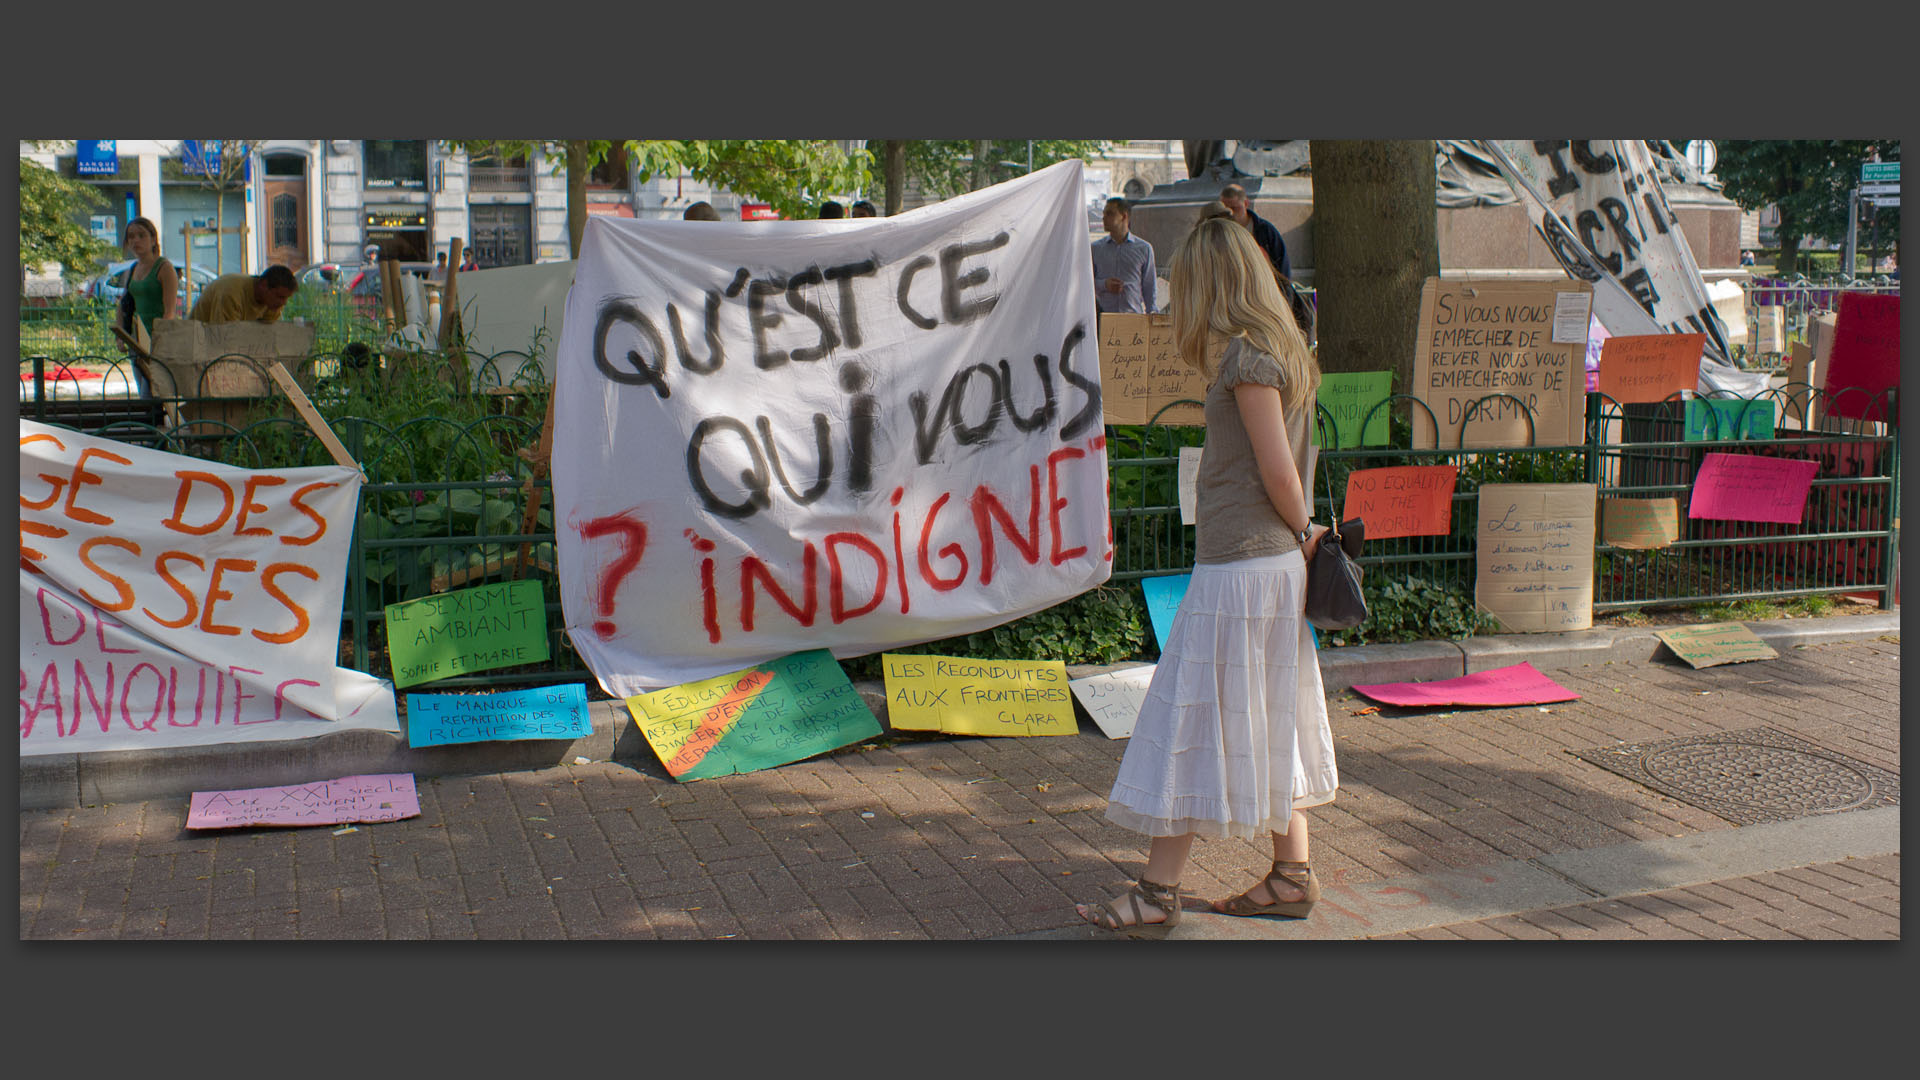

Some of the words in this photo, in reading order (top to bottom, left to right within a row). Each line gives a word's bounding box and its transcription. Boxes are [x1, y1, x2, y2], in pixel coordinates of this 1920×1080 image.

[594, 259, 878, 398] QU'EST
[897, 232, 1010, 331] CE
[1464, 305, 1500, 324] VOUS
[1505, 305, 1551, 323] NOUS
[1518, 331, 1543, 349] DE
[1432, 351, 1480, 367] REVER
[1490, 352, 1530, 370] NOUS
[1536, 352, 1567, 367] VOUS
[1432, 371, 1534, 389] EMPECHERONS
[1544, 370, 1563, 391] DE
[908, 321, 1101, 464] VOUS
[1449, 393, 1540, 425] DORMIR
[1690, 407, 1767, 437] LOVE
[1353, 478, 1377, 493] NO
[1384, 473, 1451, 490] EQUALITY
[161, 470, 339, 547] DES
[1359, 500, 1375, 514] IN
[1390, 495, 1416, 510] THE
[1367, 515, 1422, 534] WORLD
[392, 607, 411, 622] LE
[424, 584, 526, 618] SEXISME
[415, 608, 536, 647] AMBIANT
[401, 663, 440, 680] SOPHIE
[452, 654, 468, 670] ET
[474, 647, 528, 666] MARIE
[890, 663, 925, 678] LES
[637, 673, 761, 720] L'ÉDUCATION
[785, 659, 820, 678] PAS
[896, 687, 949, 707] AUX
[960, 685, 1068, 705] FRONTIÈRES
[456, 697, 528, 712] MANQUE
[546, 693, 568, 704] DE
[647, 719, 702, 740] ASSEZ
[794, 678, 818, 694] DE
[533, 710, 555, 719] DES
[742, 732, 763, 747] DE
[771, 723, 790, 736] LA
[793, 699, 866, 731] PERSONNE
[765, 707, 786, 723] DE
[998, 711, 1058, 726] CLARA
[429, 722, 568, 742] RICHESSES
[303, 795, 374, 808] VIVENT
[225, 812, 276, 822] DANS
[296, 809, 318, 817] LA
